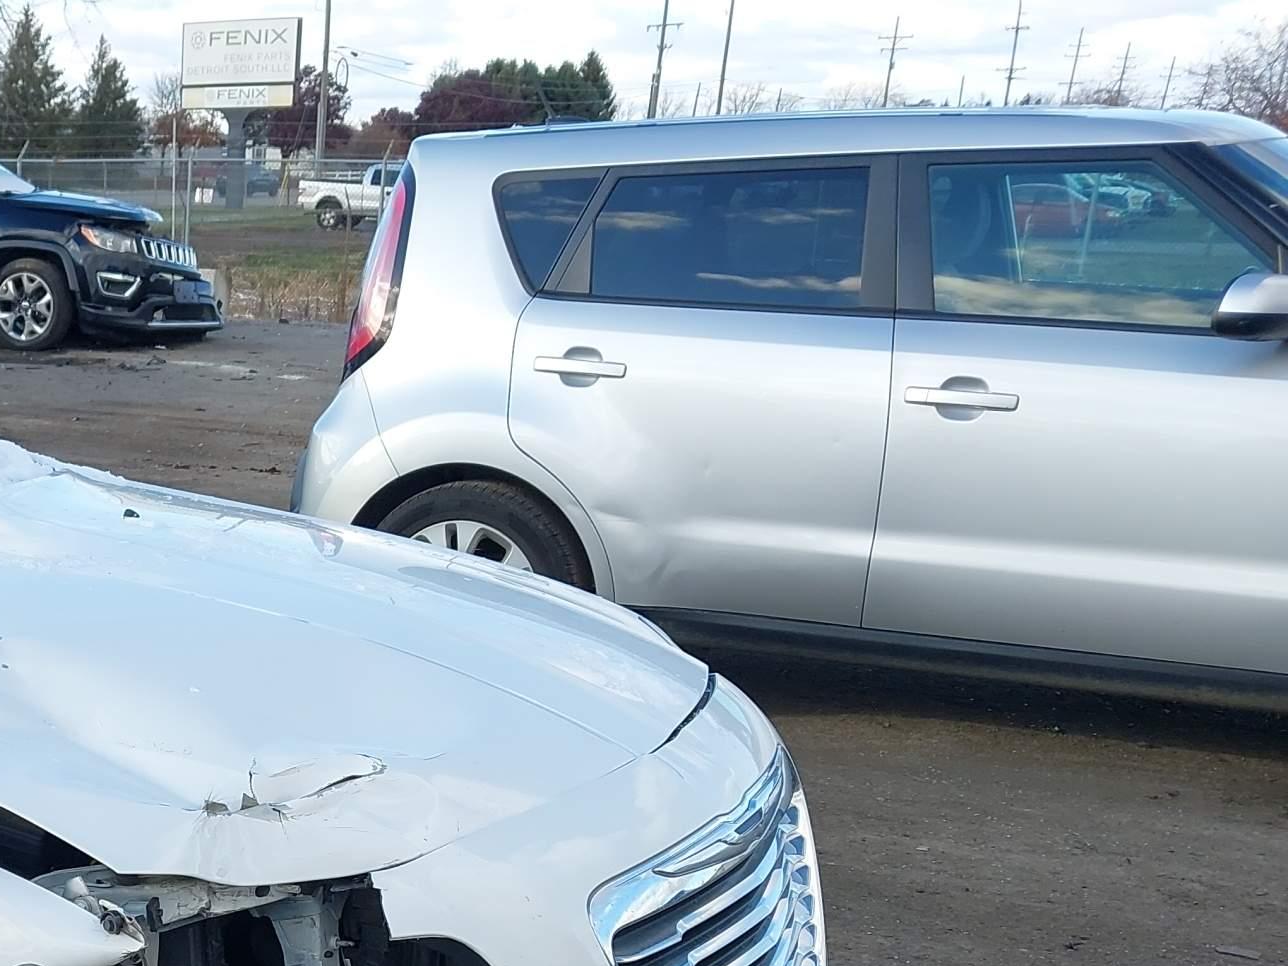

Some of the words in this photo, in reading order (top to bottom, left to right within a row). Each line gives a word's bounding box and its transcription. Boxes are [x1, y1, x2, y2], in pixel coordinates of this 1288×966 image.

[209, 28, 288, 47] FENIX
[223, 53, 254, 63] FENIX
[257, 51, 290, 62] PARTS
[187, 64, 229, 75] DETROIT
[271, 62, 290, 73] LLC
[217, 87, 266, 100] FENIX
